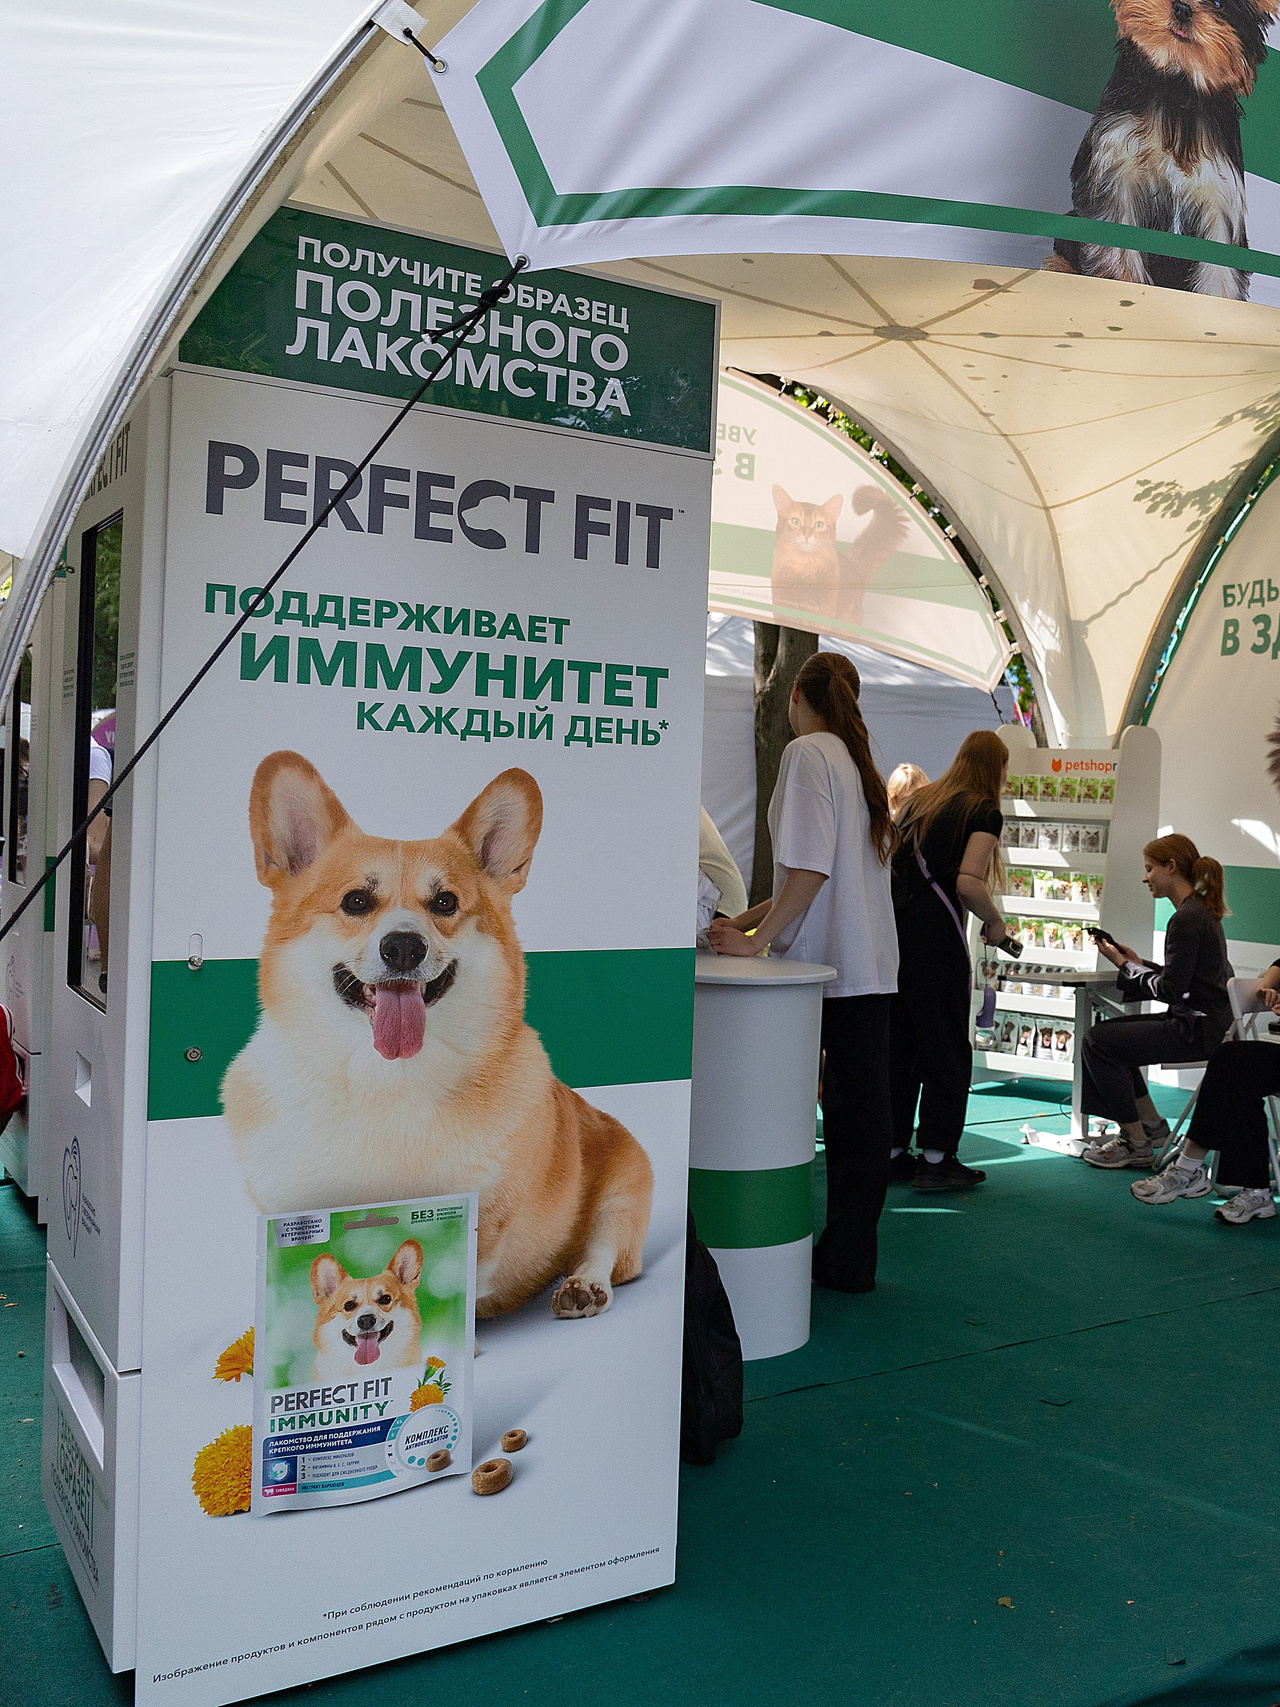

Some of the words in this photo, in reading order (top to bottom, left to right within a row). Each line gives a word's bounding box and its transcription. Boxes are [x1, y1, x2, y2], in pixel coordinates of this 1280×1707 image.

[297, 235, 483, 298] ПОЛУЧИТЕ
[490, 279, 630, 334] ОБРАЗЕЦ
[295, 269, 629, 372] ПОЛЕЗНОГО
[285, 316, 632, 416] ЛАКОМСТВА
[204, 439, 555, 555] PERFECT
[204, 582, 571, 645] ПОДДЕРЖИВАЕТ
[1220, 617, 1240, 656] В
[239, 631, 669, 710] ИММУНИТЕТ
[356, 701, 553, 742] КАЖДЫЙ
[283, 1218, 323, 1227] РАЗРАБОТАНО
[411, 1209, 434, 1220] БЕЗ
[270, 1382, 359, 1414] PERFECT
[363, 1376, 393, 1400] FIT
[268, 1434, 314, 1447] ЛАКОМСТВО
[313, 1432, 329, 1443] ДЛЯ
[328, 1425, 381, 1441] ПОДДЕРЖАНИЯ
[270, 1400, 389, 1433] IMMUNITY
[404, 1425, 449, 1445] КОМПЛЕКС
[268, 1443, 306, 1455] КРЕПКОГО
[305, 1438, 353, 1450] ИММУНИТЕТА
[300, 1464, 306, 1472] 2
[300, 1472, 306, 1480] 3
[349, 1593, 411, 1614] соблюдении
[412, 1574, 481, 1600] рекомендаций
[483, 1572, 494, 1581] по
[496, 1558, 549, 1578] кормлению
[152, 1657, 229, 1683] Изображение
[231, 1642, 286, 1664] продуктов
[288, 1640, 295, 1649] и
[297, 1622, 364, 1646] компонентов
[365, 1614, 397, 1631] рядом
[406, 1600, 457, 1619] продуктом
[459, 1595, 470, 1605] на
[471, 1583, 517, 1603] упаковках
[518, 1573, 558, 1589] является
[559, 1561, 606, 1579] элементом
[607, 1547, 660, 1566] оформления
